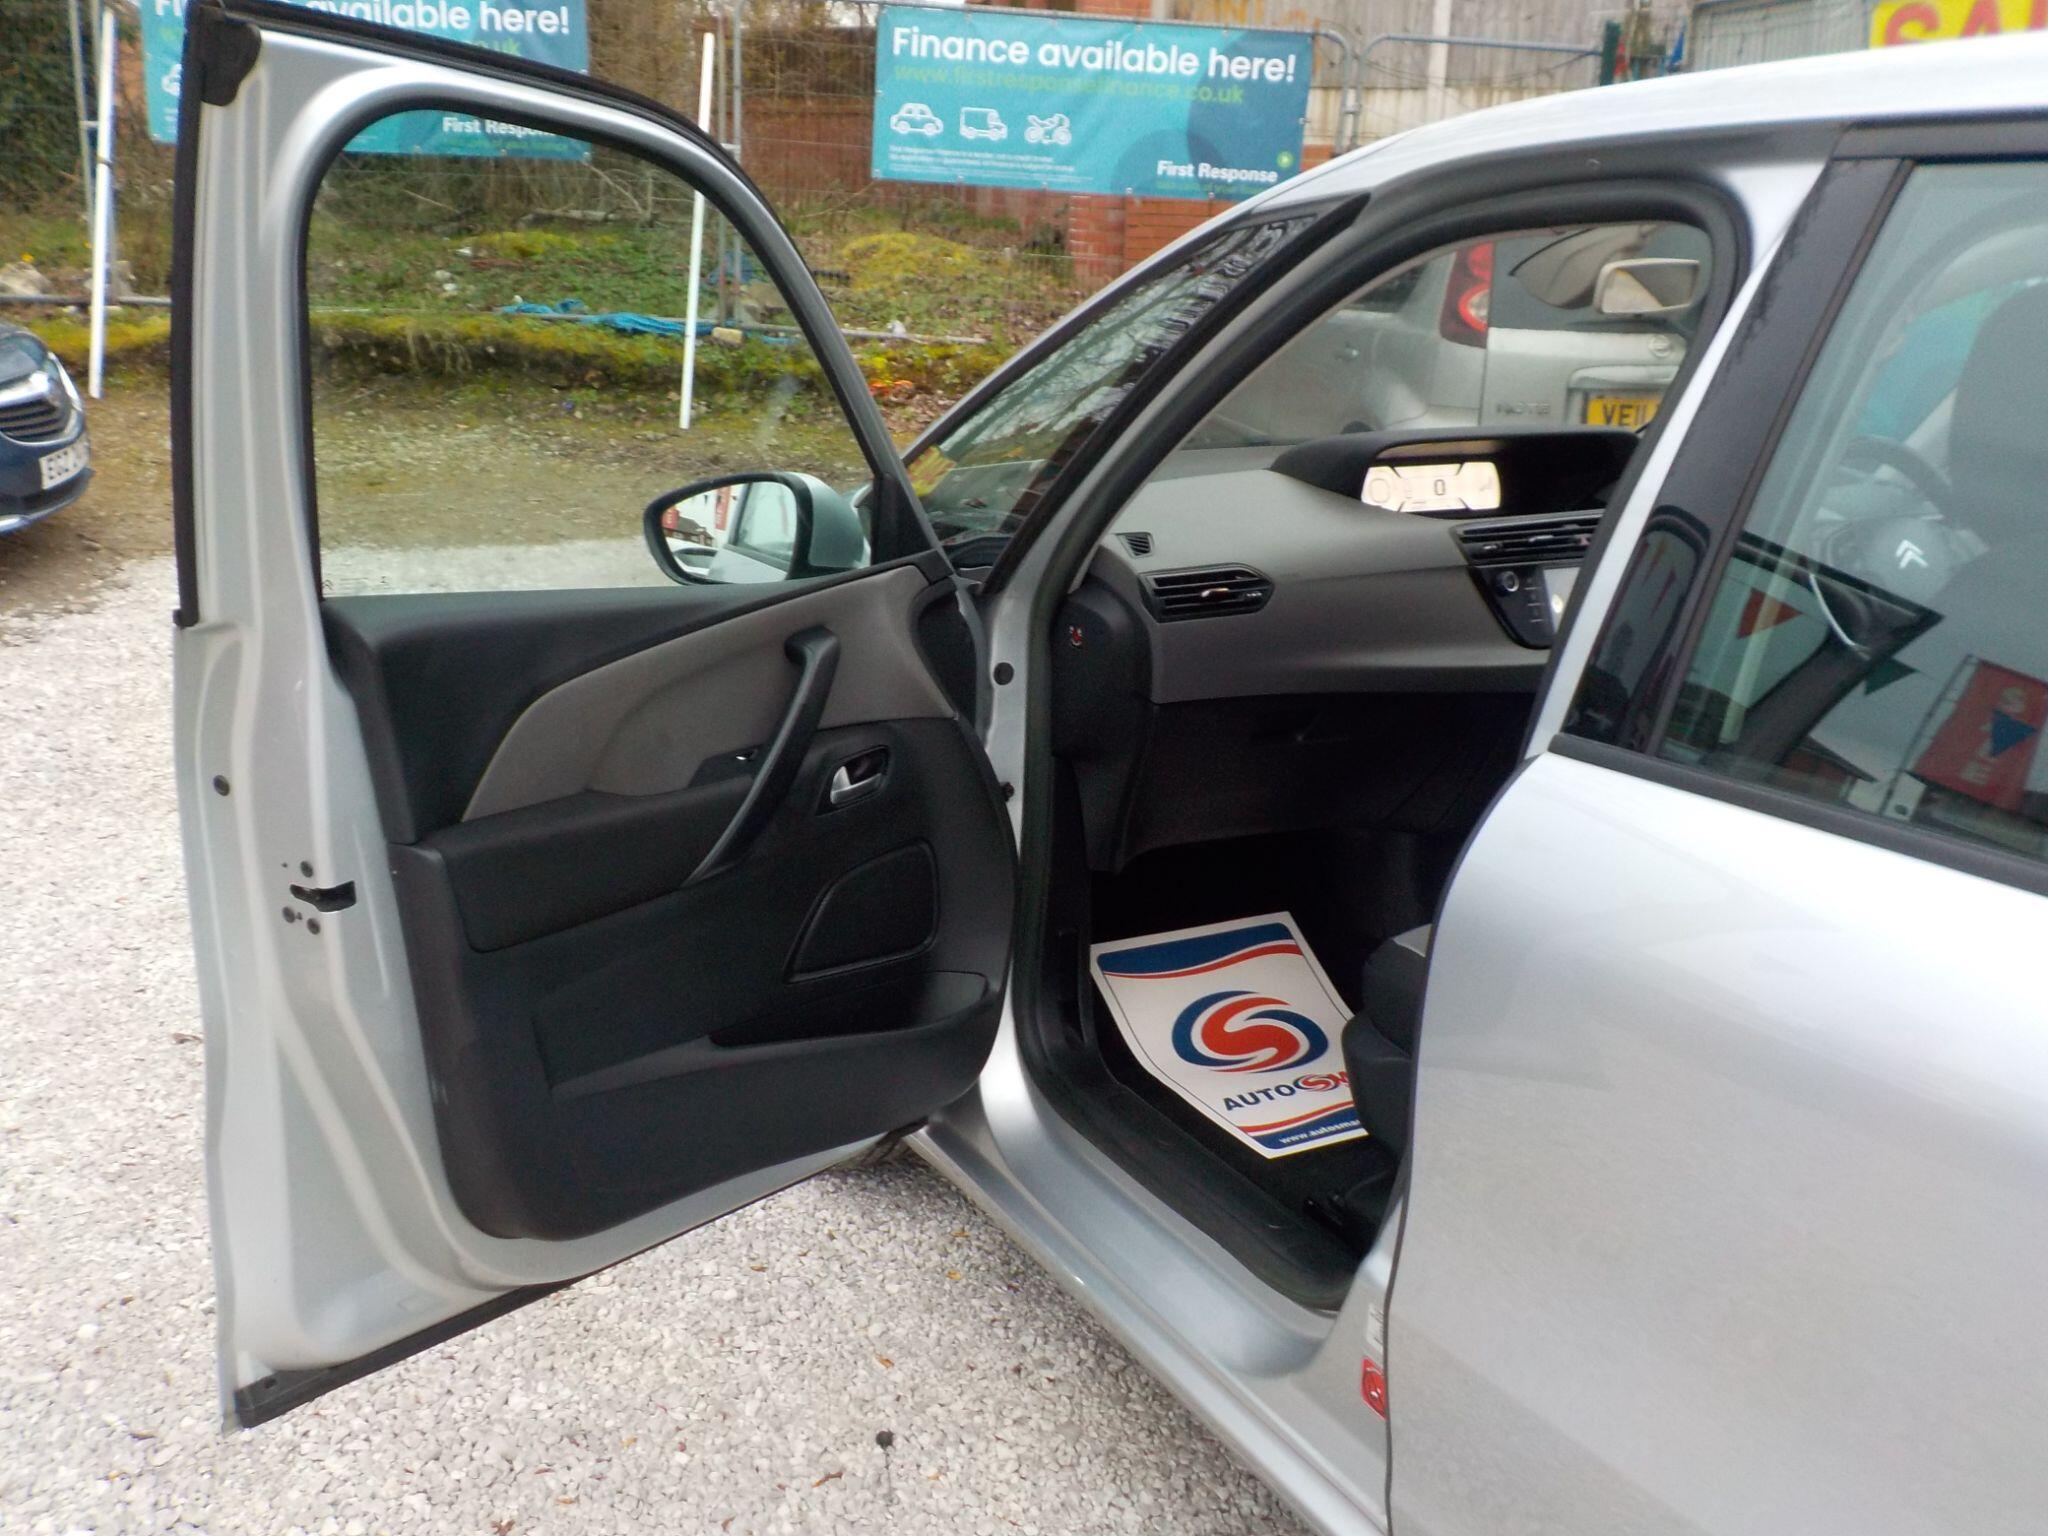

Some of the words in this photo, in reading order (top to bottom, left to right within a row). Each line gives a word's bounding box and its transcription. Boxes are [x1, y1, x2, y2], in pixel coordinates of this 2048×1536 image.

[479, 1, 569, 34] here!
[891, 26, 1030, 65] Finance
[1037, 40, 1199, 76] available
[1208, 46, 1296, 83] here!
[442, 116, 482, 134] First
[1156, 160, 1195, 177] First
[1198, 162, 1279, 182] Response
